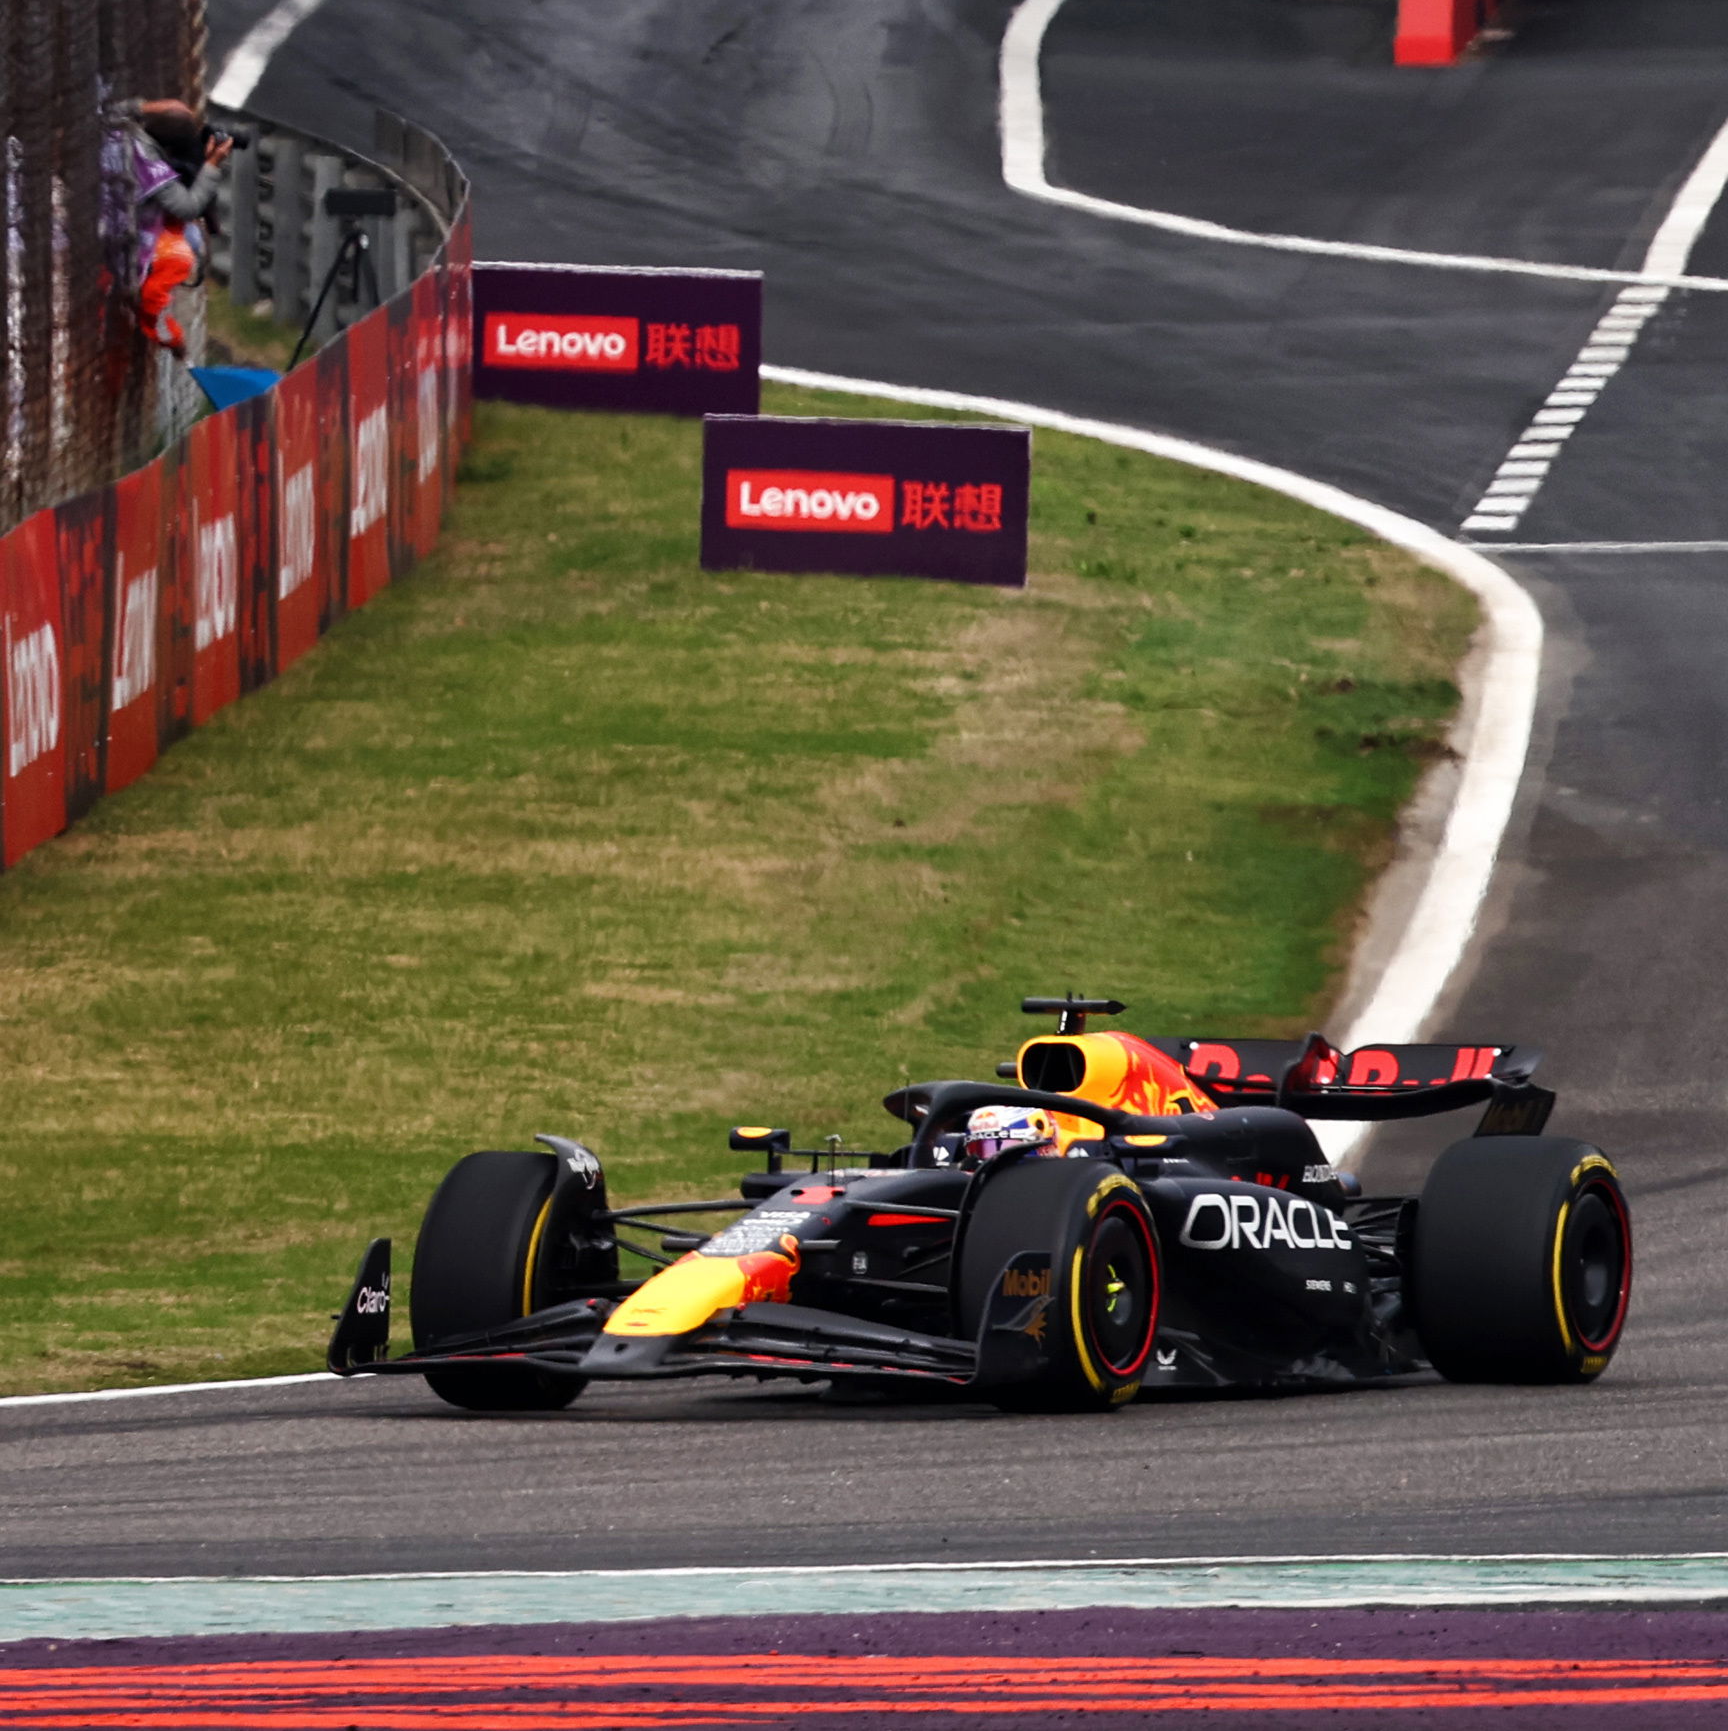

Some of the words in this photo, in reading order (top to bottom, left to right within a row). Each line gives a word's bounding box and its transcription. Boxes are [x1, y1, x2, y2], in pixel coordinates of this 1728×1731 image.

[494, 323, 628, 362] Lenovo
[645, 321, 741, 369] 联想
[738, 478, 881, 522] Lenovo
[900, 478, 1004, 533] 联想
[1179, 1193, 1352, 1251] ORACLE
